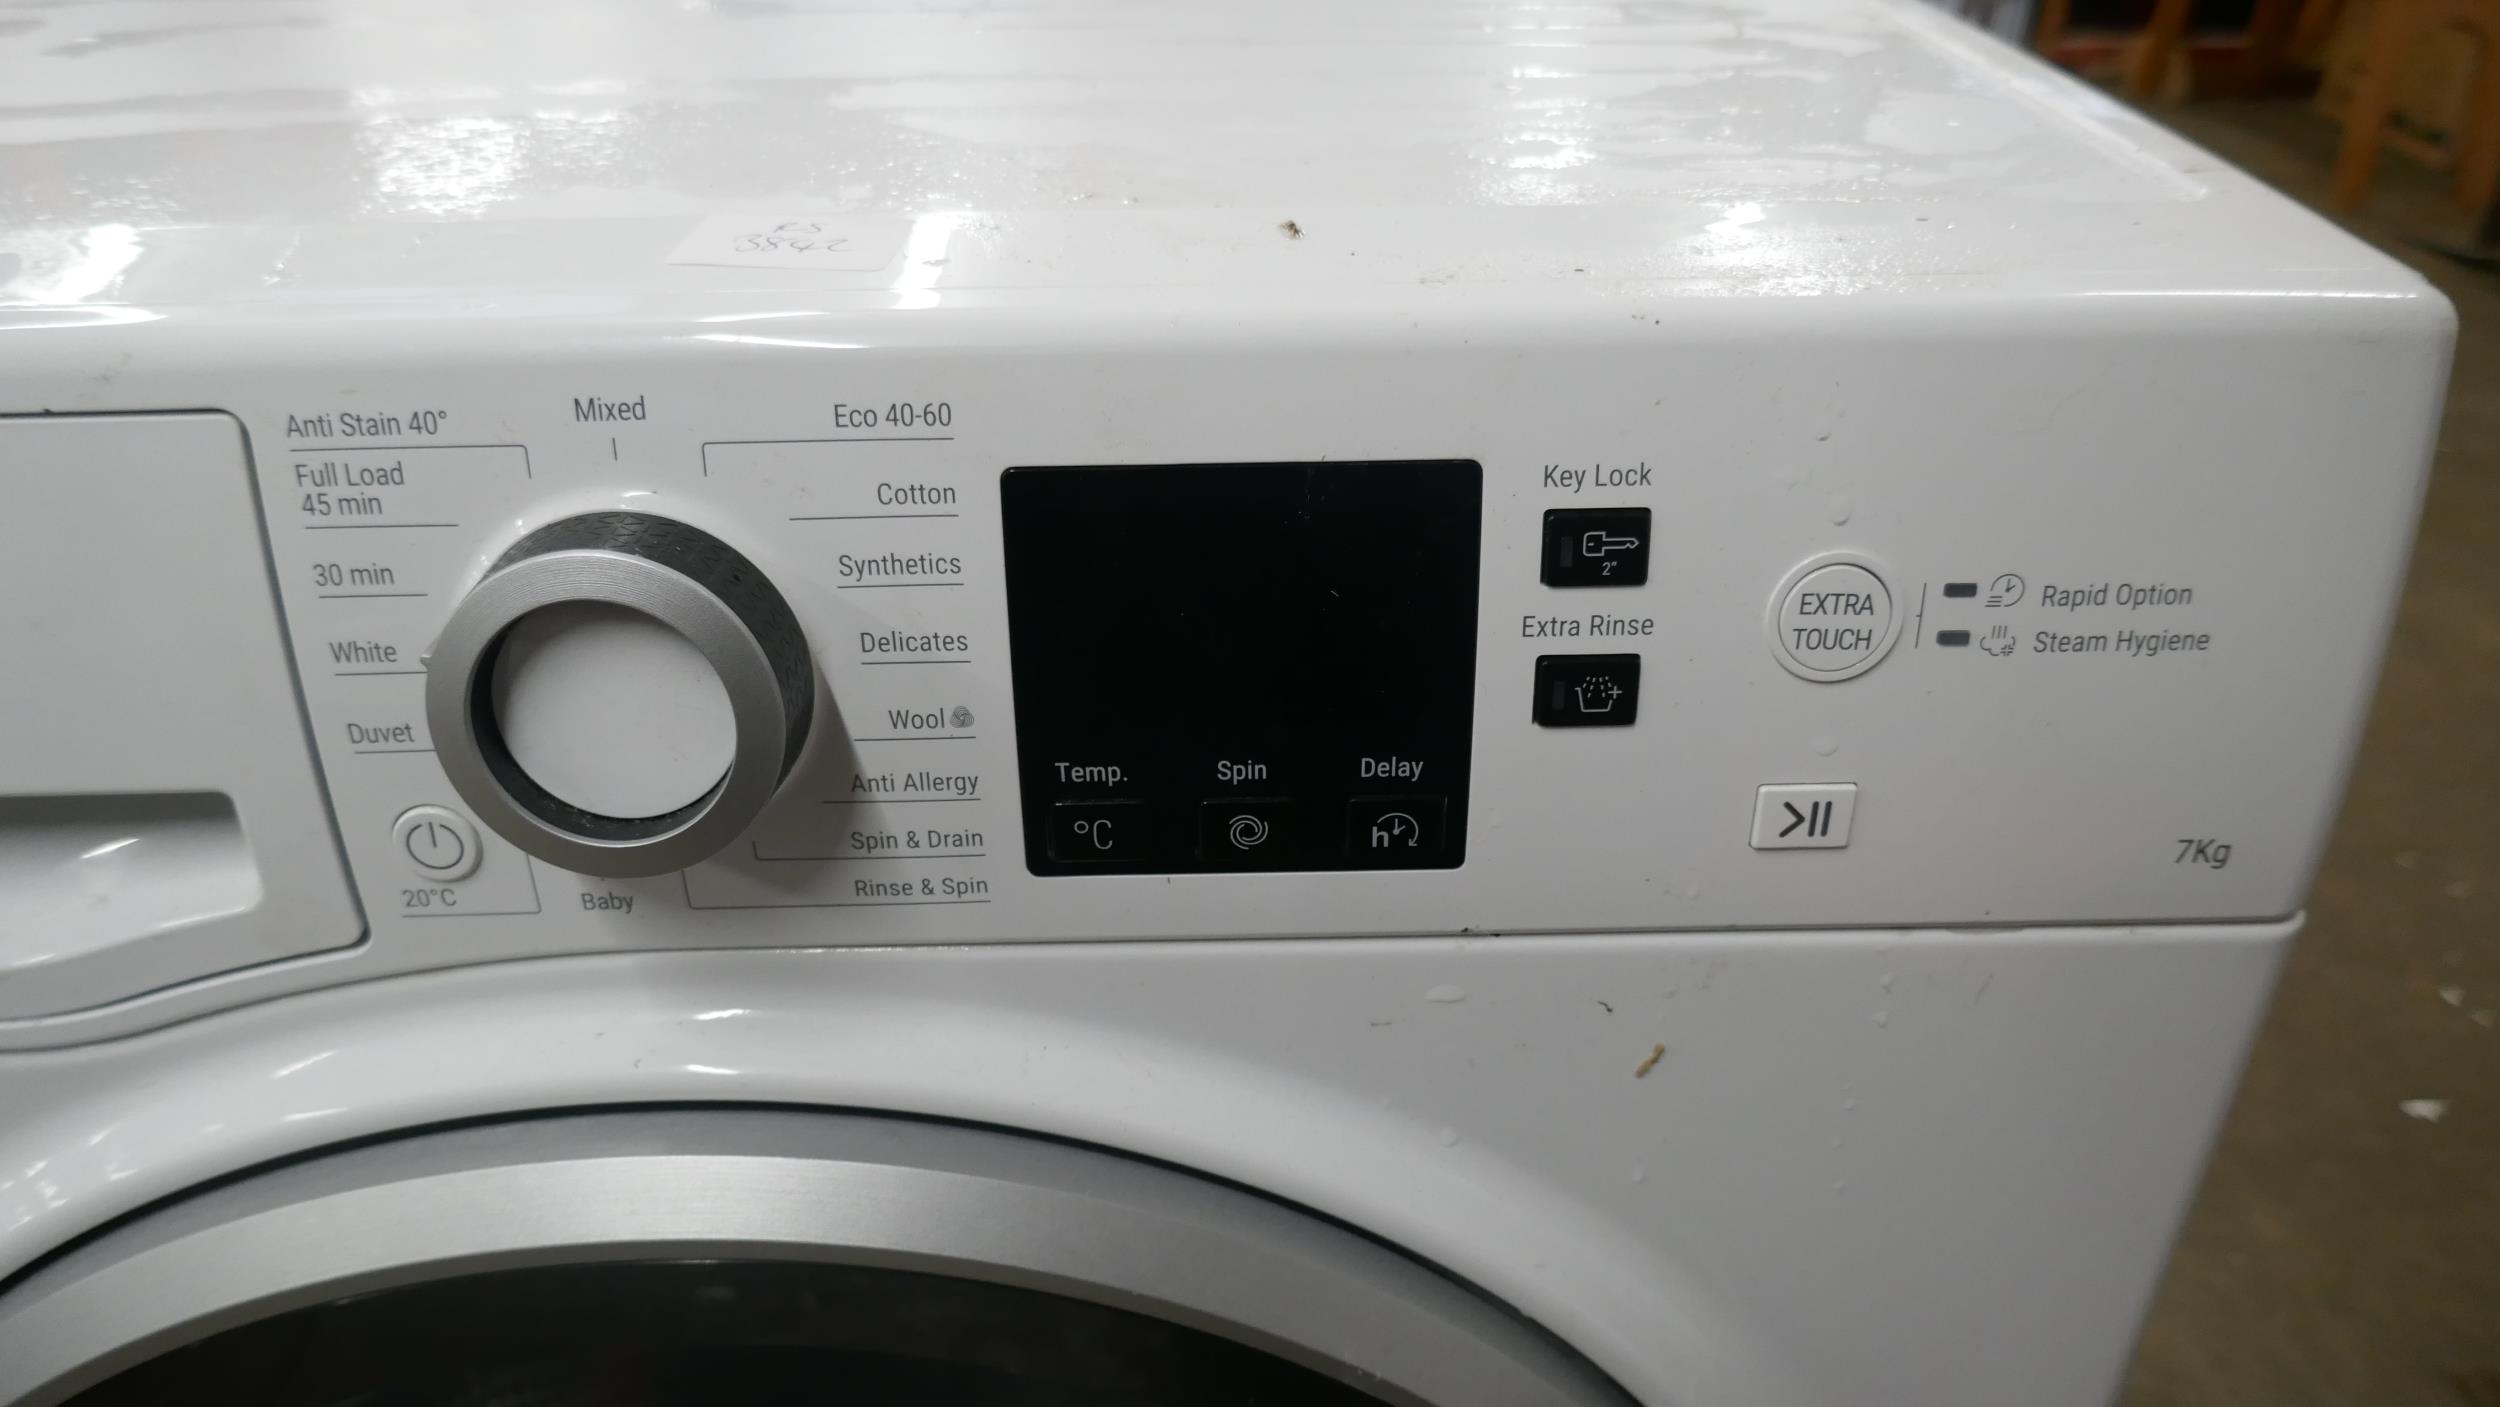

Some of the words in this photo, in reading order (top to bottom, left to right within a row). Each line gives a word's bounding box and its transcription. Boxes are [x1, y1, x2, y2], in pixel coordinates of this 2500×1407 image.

[574, 395, 647, 422] Mixed
[833, 403, 878, 428] Eco
[885, 402, 952, 427] 40-60
[286, 414, 334, 439] Anti
[340, 411, 401, 437] Stain
[408, 410, 448, 436] 40°
[294, 462, 338, 488] Full
[345, 461, 405, 487] Load
[1543, 464, 1586, 494] Key
[1594, 462, 1652, 488] Lock
[301, 493, 332, 516] 45
[338, 493, 383, 515] min
[877, 483, 956, 505] Cotton
[312, 563, 343, 587] 30
[350, 562, 395, 585] min
[838, 553, 962, 582] Synthetics
[1799, 593, 1875, 616] EXTRA
[2041, 583, 2109, 612] Rapid
[2115, 583, 2193, 611] Option
[1521, 615, 1581, 638] Extra
[1589, 614, 1654, 636] Rinse
[859, 631, 969, 653] Delicates
[1792, 628, 1872, 651] TOUCH
[2033, 631, 2108, 653] Steam
[2114, 630, 2210, 657] Hygiene
[328, 641, 398, 664] White
[888, 707, 945, 730] Wool
[346, 723, 416, 745] Duvet
[1055, 762, 1128, 786] Temp.
[1217, 760, 1267, 786] Spin
[1360, 757, 1424, 781] Delay
[852, 774, 895, 793] Anti
[903, 772, 979, 795] Allergy
[850, 831, 899, 854] Spin
[906, 832, 921, 849] &
[928, 830, 984, 849] Drain
[2174, 838, 2232, 870] 7Kg
[401, 888, 457, 908] 20°C
[854, 879, 914, 897] Rinse
[921, 878, 935, 896] &
[942, 877, 989, 898] Spin
[581, 892, 634, 914] Baby
